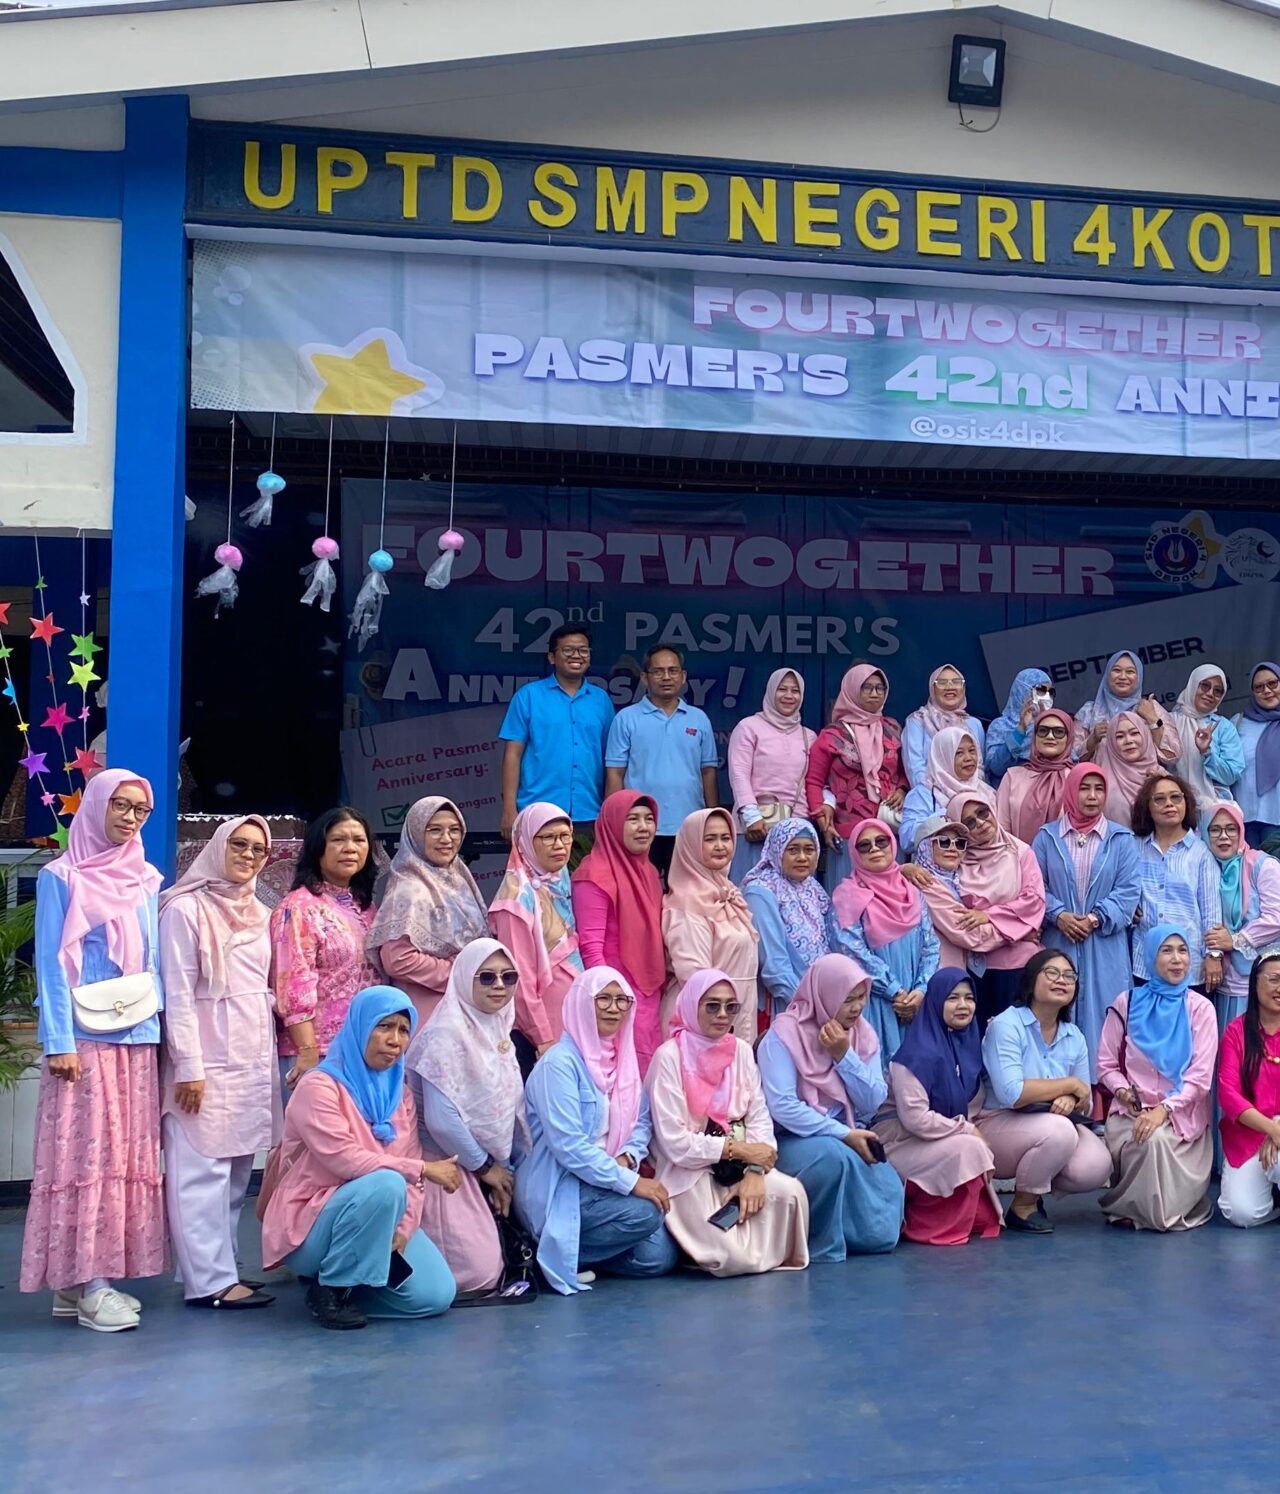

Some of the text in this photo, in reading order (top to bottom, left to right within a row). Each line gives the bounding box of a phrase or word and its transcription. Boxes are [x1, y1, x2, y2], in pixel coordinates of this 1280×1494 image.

[244, 141, 503, 222] UPTD
[528, 162, 709, 237] SMP
[728, 176, 1046, 263] NEGERI
[1073, 204, 1117, 266] 4
[693, 285, 1262, 358] FOURTWOGETHER
[475, 333, 850, 396] PASMER'S
[885, 354, 1089, 410] 42nd
[909, 415, 1066, 449] @osis4dpk
[362, 525, 1115, 595] FOURTWOGETHER
[474, 601, 899, 656] 42nd PASMER'S
[1039, 637, 1205, 684] EPTMBER
[372, 740, 499, 771] Acara Pasmer
[377, 763, 489, 791] Anniversary:
